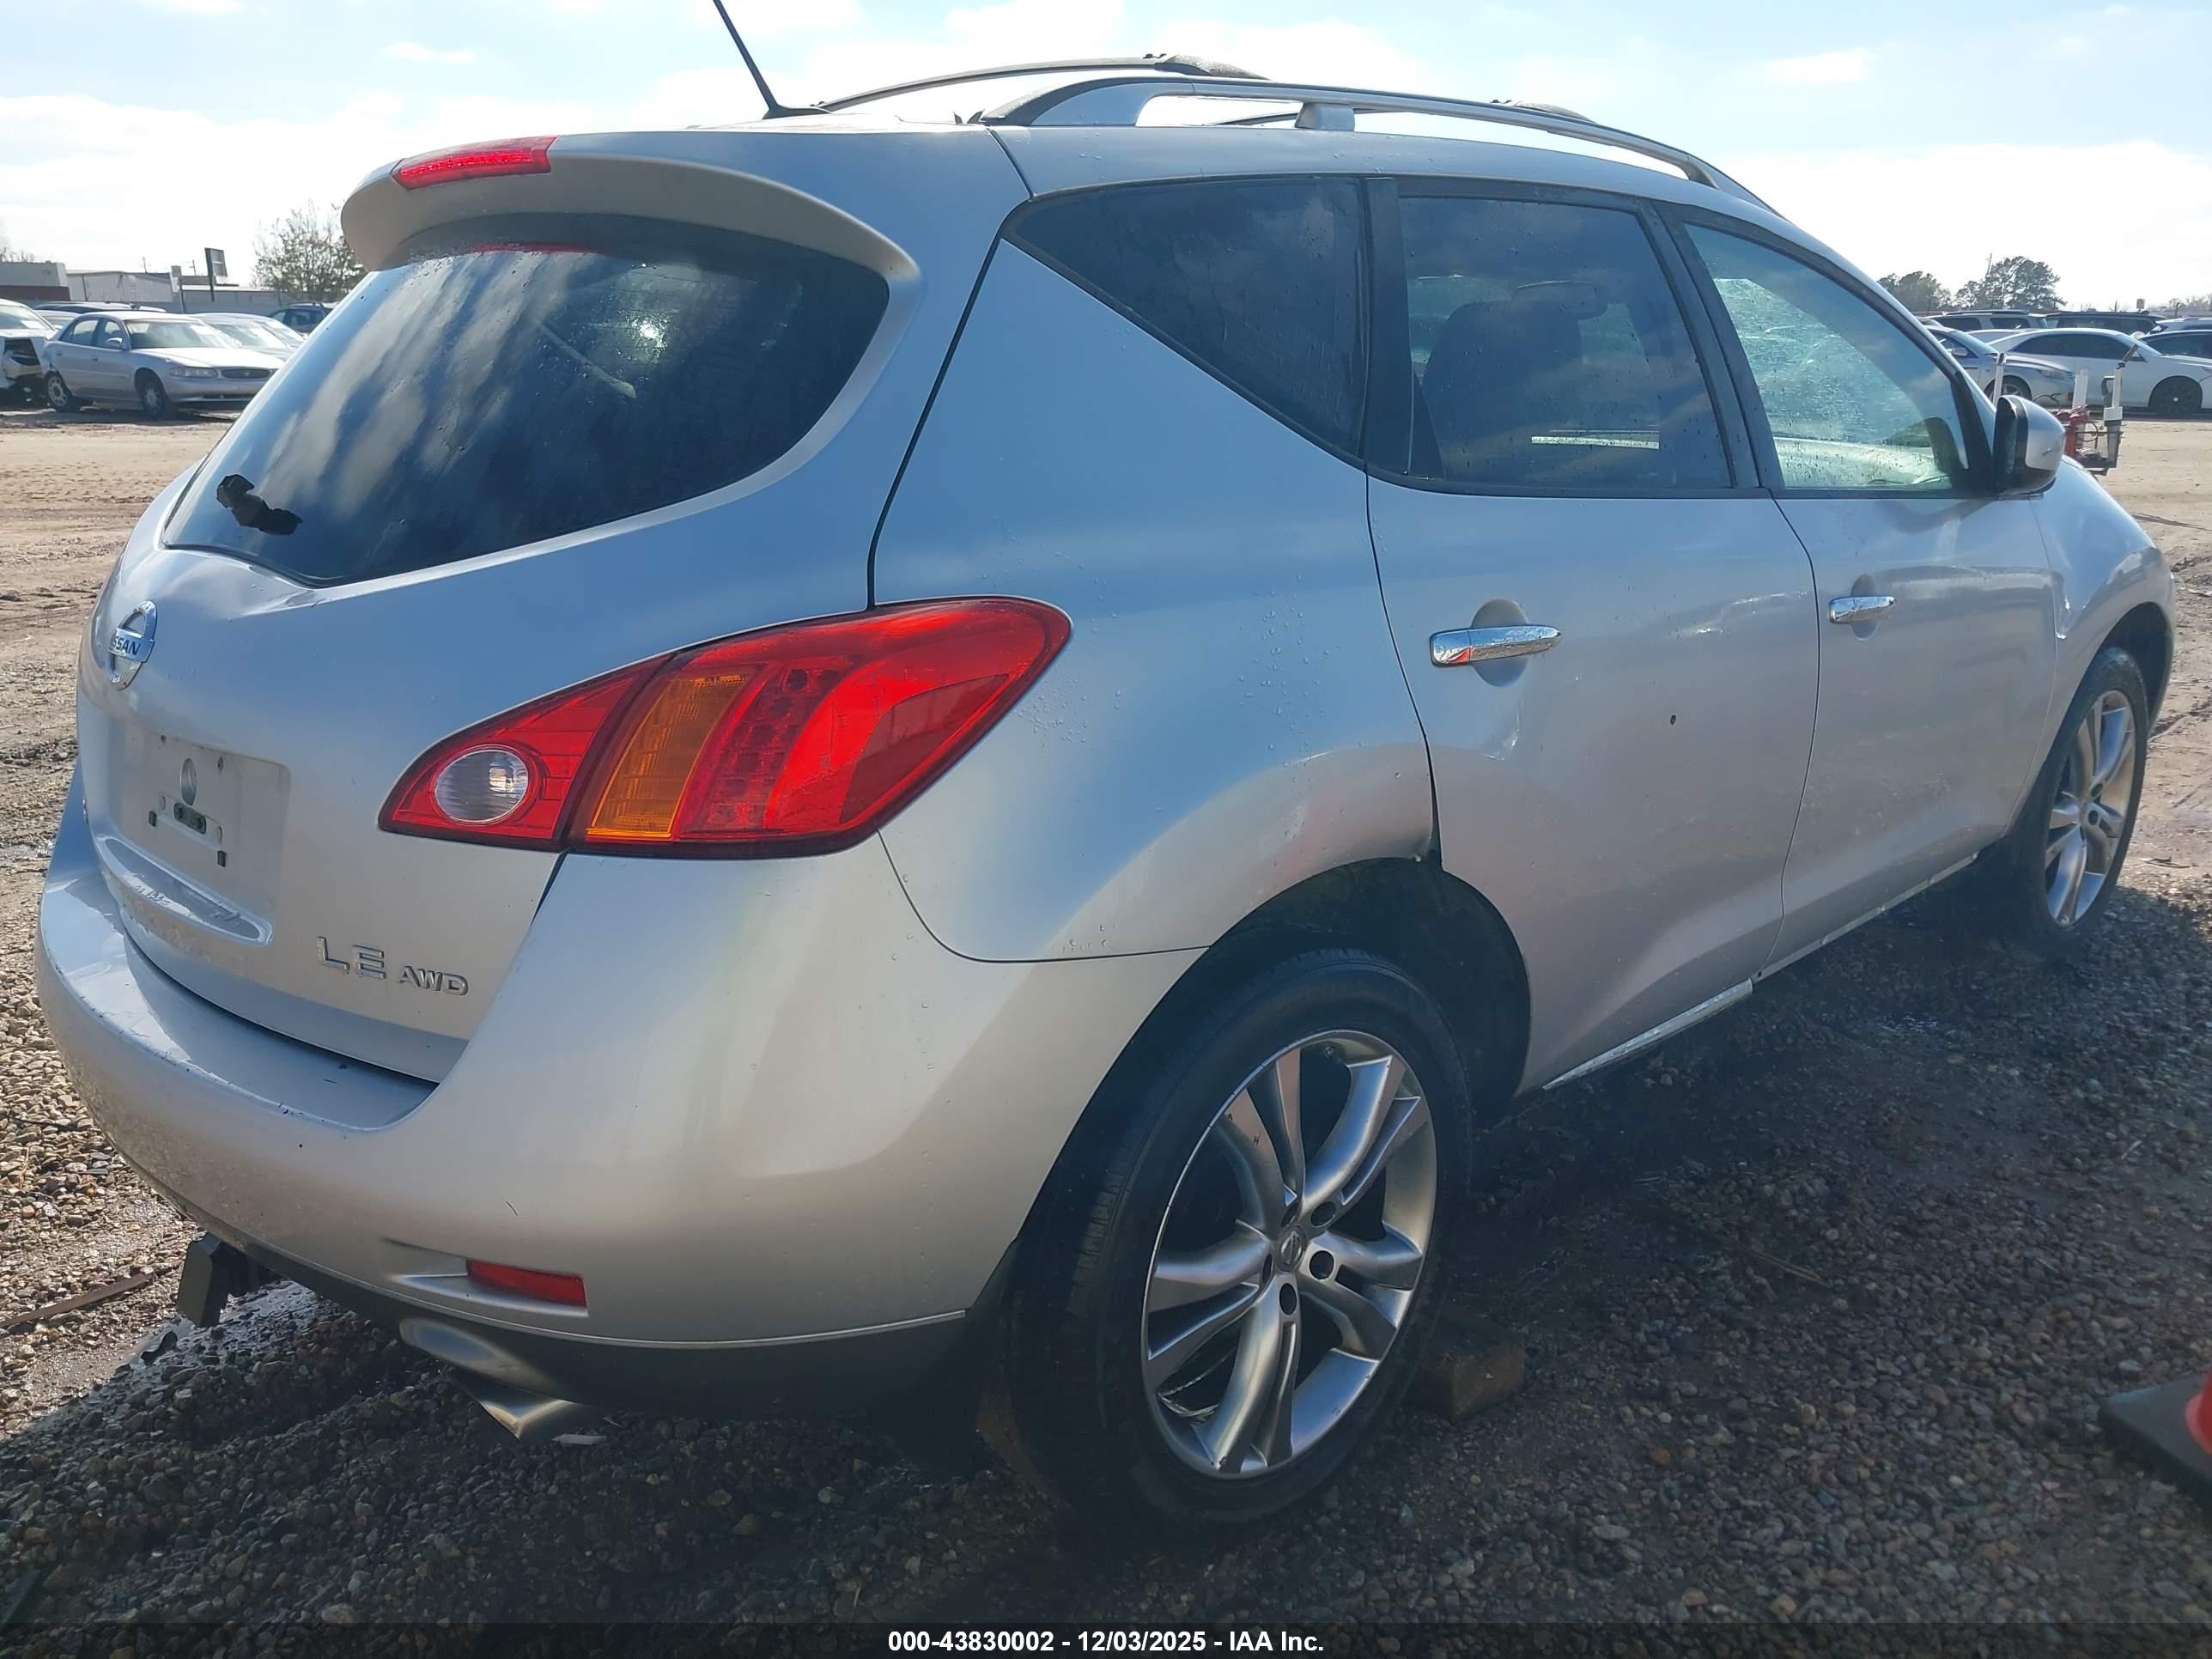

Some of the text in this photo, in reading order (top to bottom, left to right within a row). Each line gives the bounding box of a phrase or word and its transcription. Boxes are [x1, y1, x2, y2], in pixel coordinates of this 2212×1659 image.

[110, 635, 141, 655] SSAN
[315, 936, 470, 996] LE AWD
